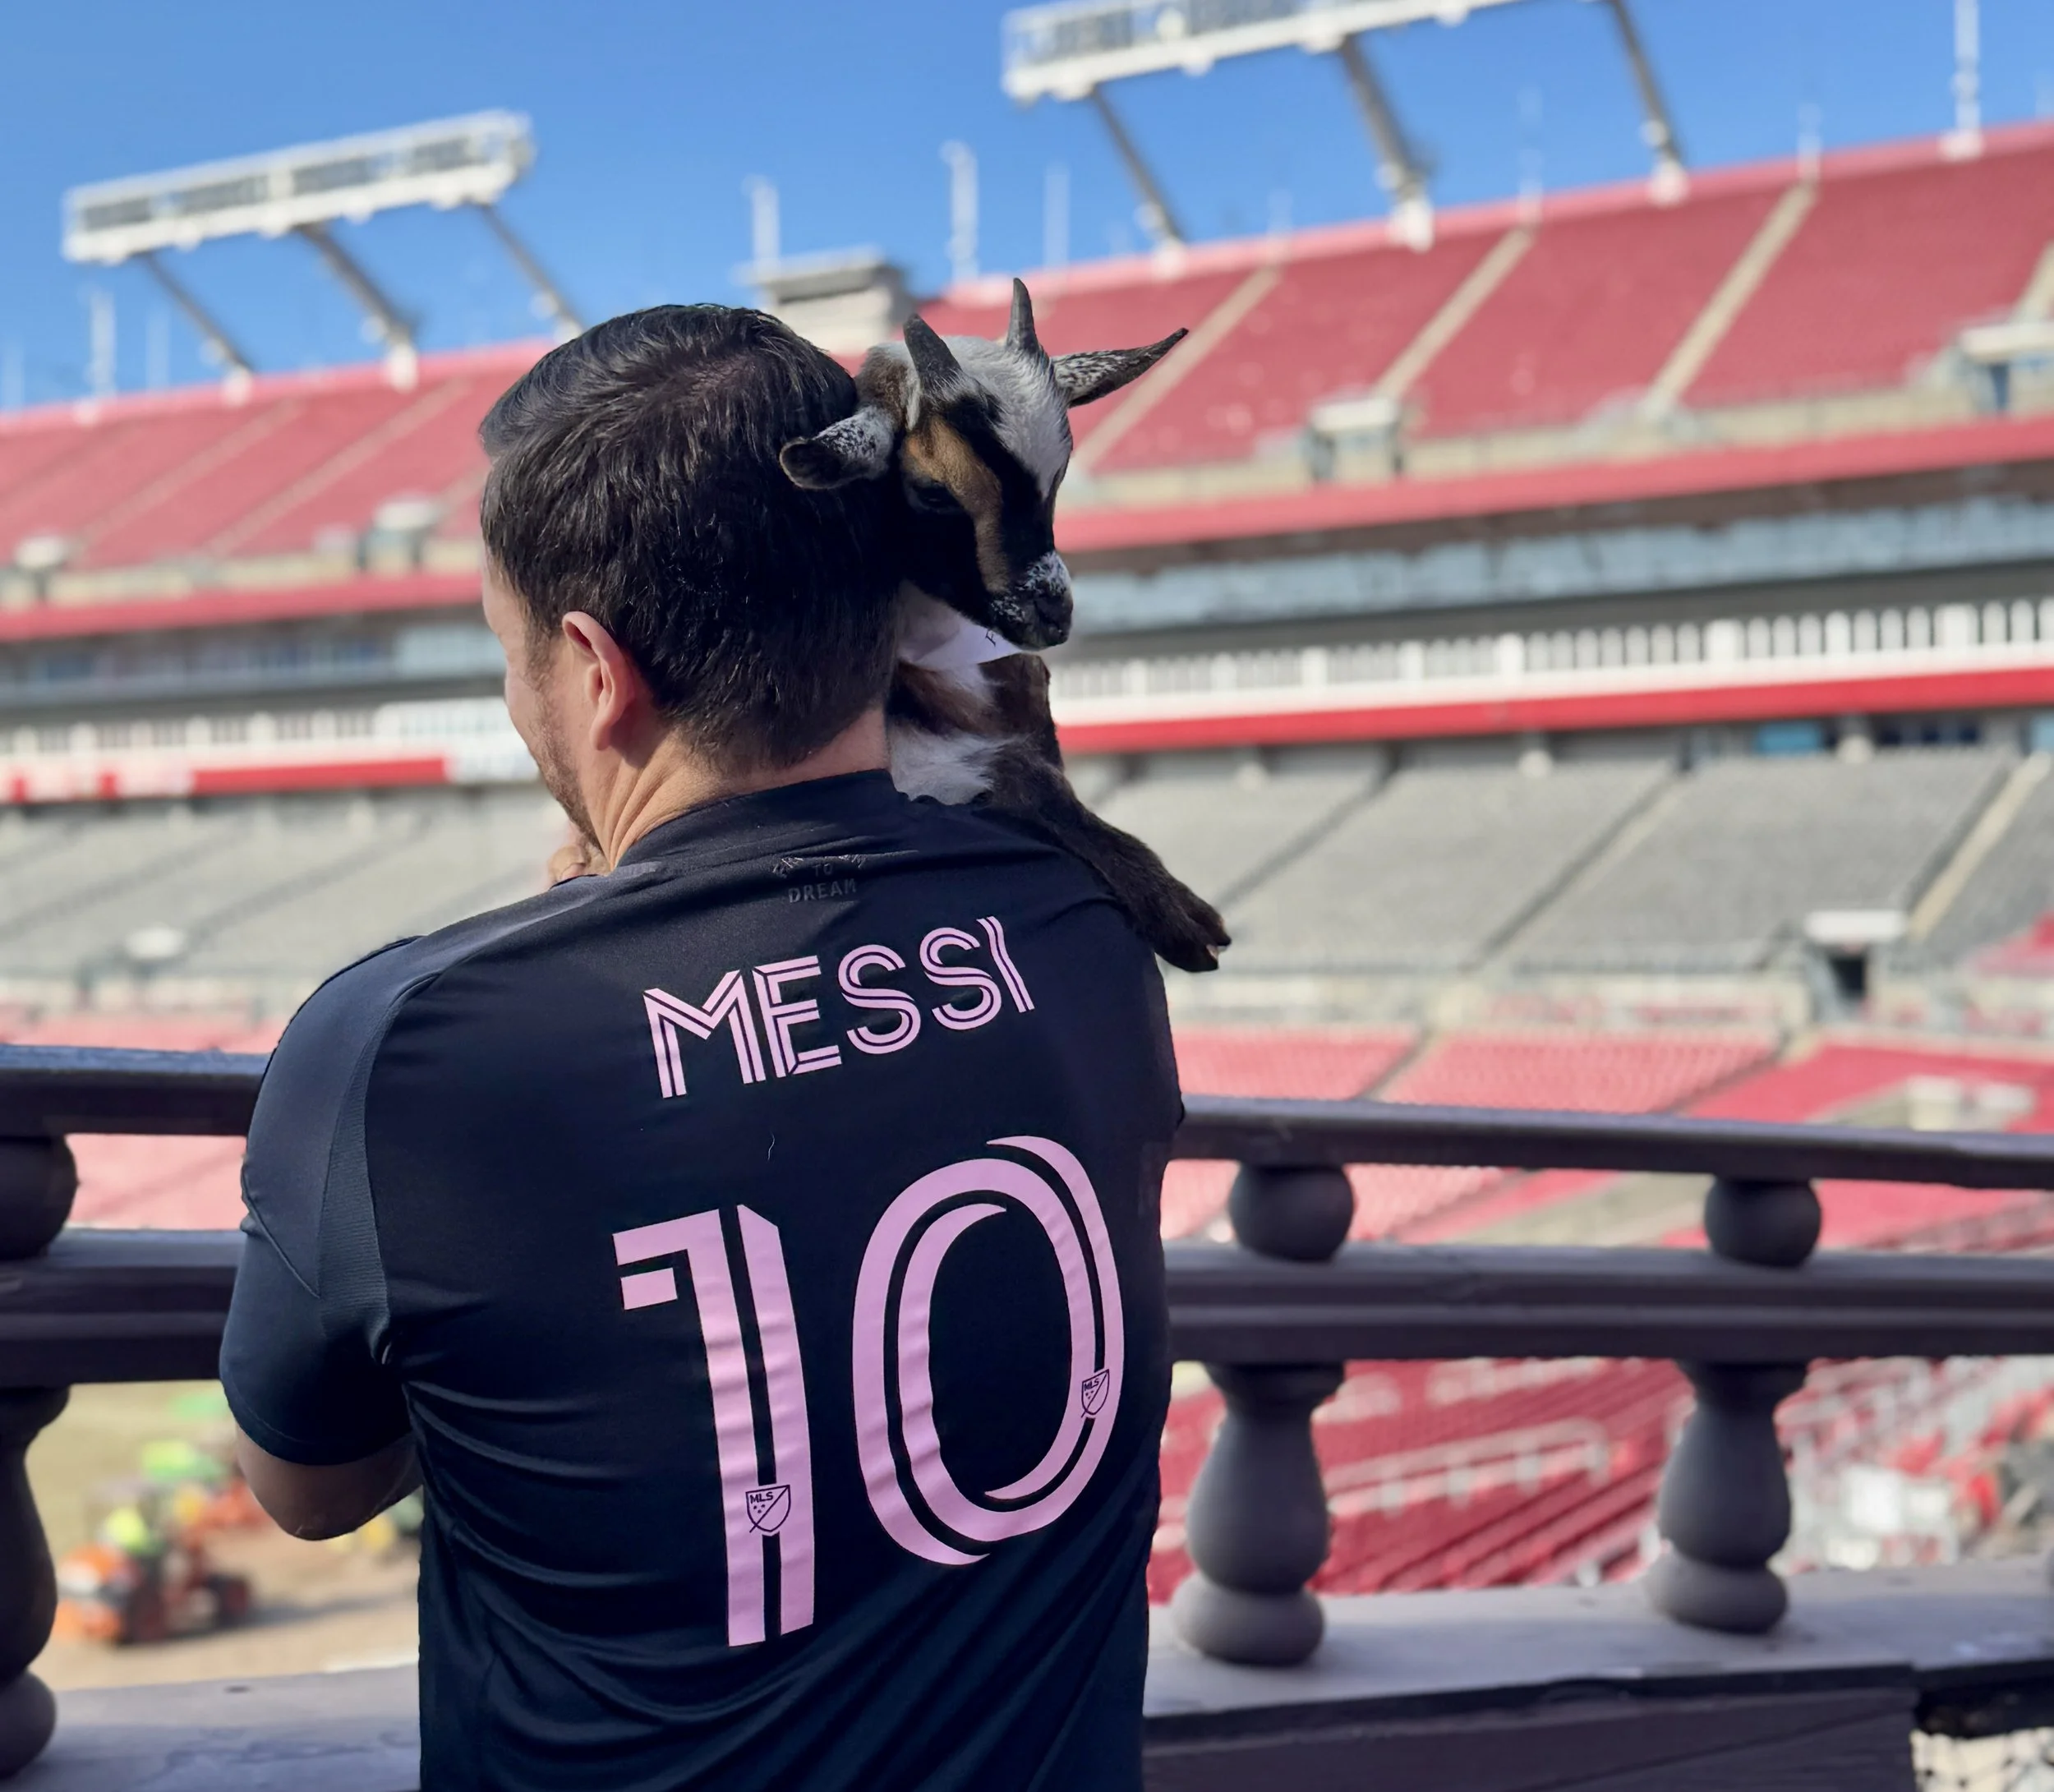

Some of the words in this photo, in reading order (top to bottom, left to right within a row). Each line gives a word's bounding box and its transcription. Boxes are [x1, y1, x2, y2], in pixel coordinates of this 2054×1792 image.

[812, 863, 833, 877] TO
[789, 879, 856, 902] DREAM
[643, 916, 1034, 1099] MESSI
[612, 1136, 1124, 1647] 10
[1085, 1378, 1099, 1391] MLS
[749, 1491, 774, 1504] MLS
